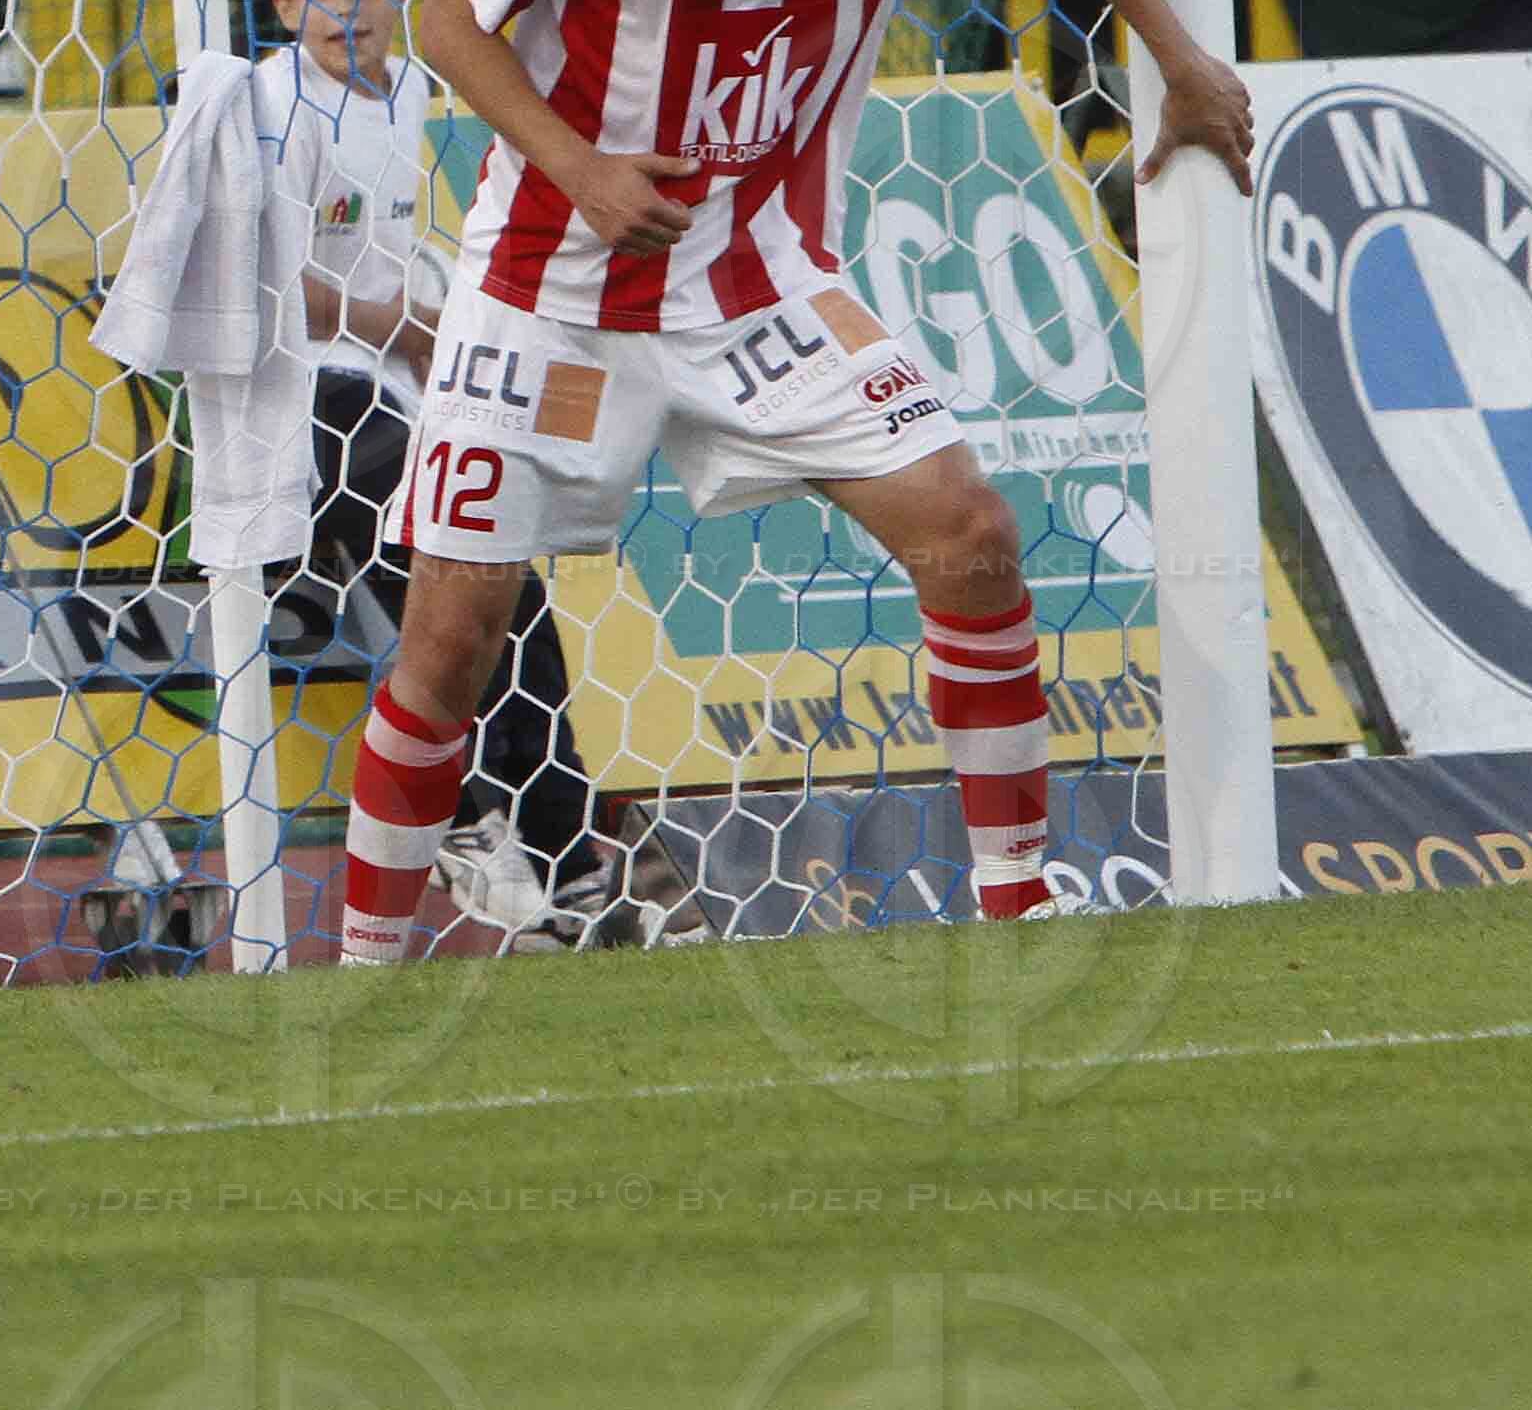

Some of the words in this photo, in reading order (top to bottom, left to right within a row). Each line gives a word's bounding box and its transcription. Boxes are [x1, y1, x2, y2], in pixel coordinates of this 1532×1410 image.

[439, 341, 530, 409] JCL
[722, 313, 827, 407] JCL
[425, 440, 504, 534] 12
